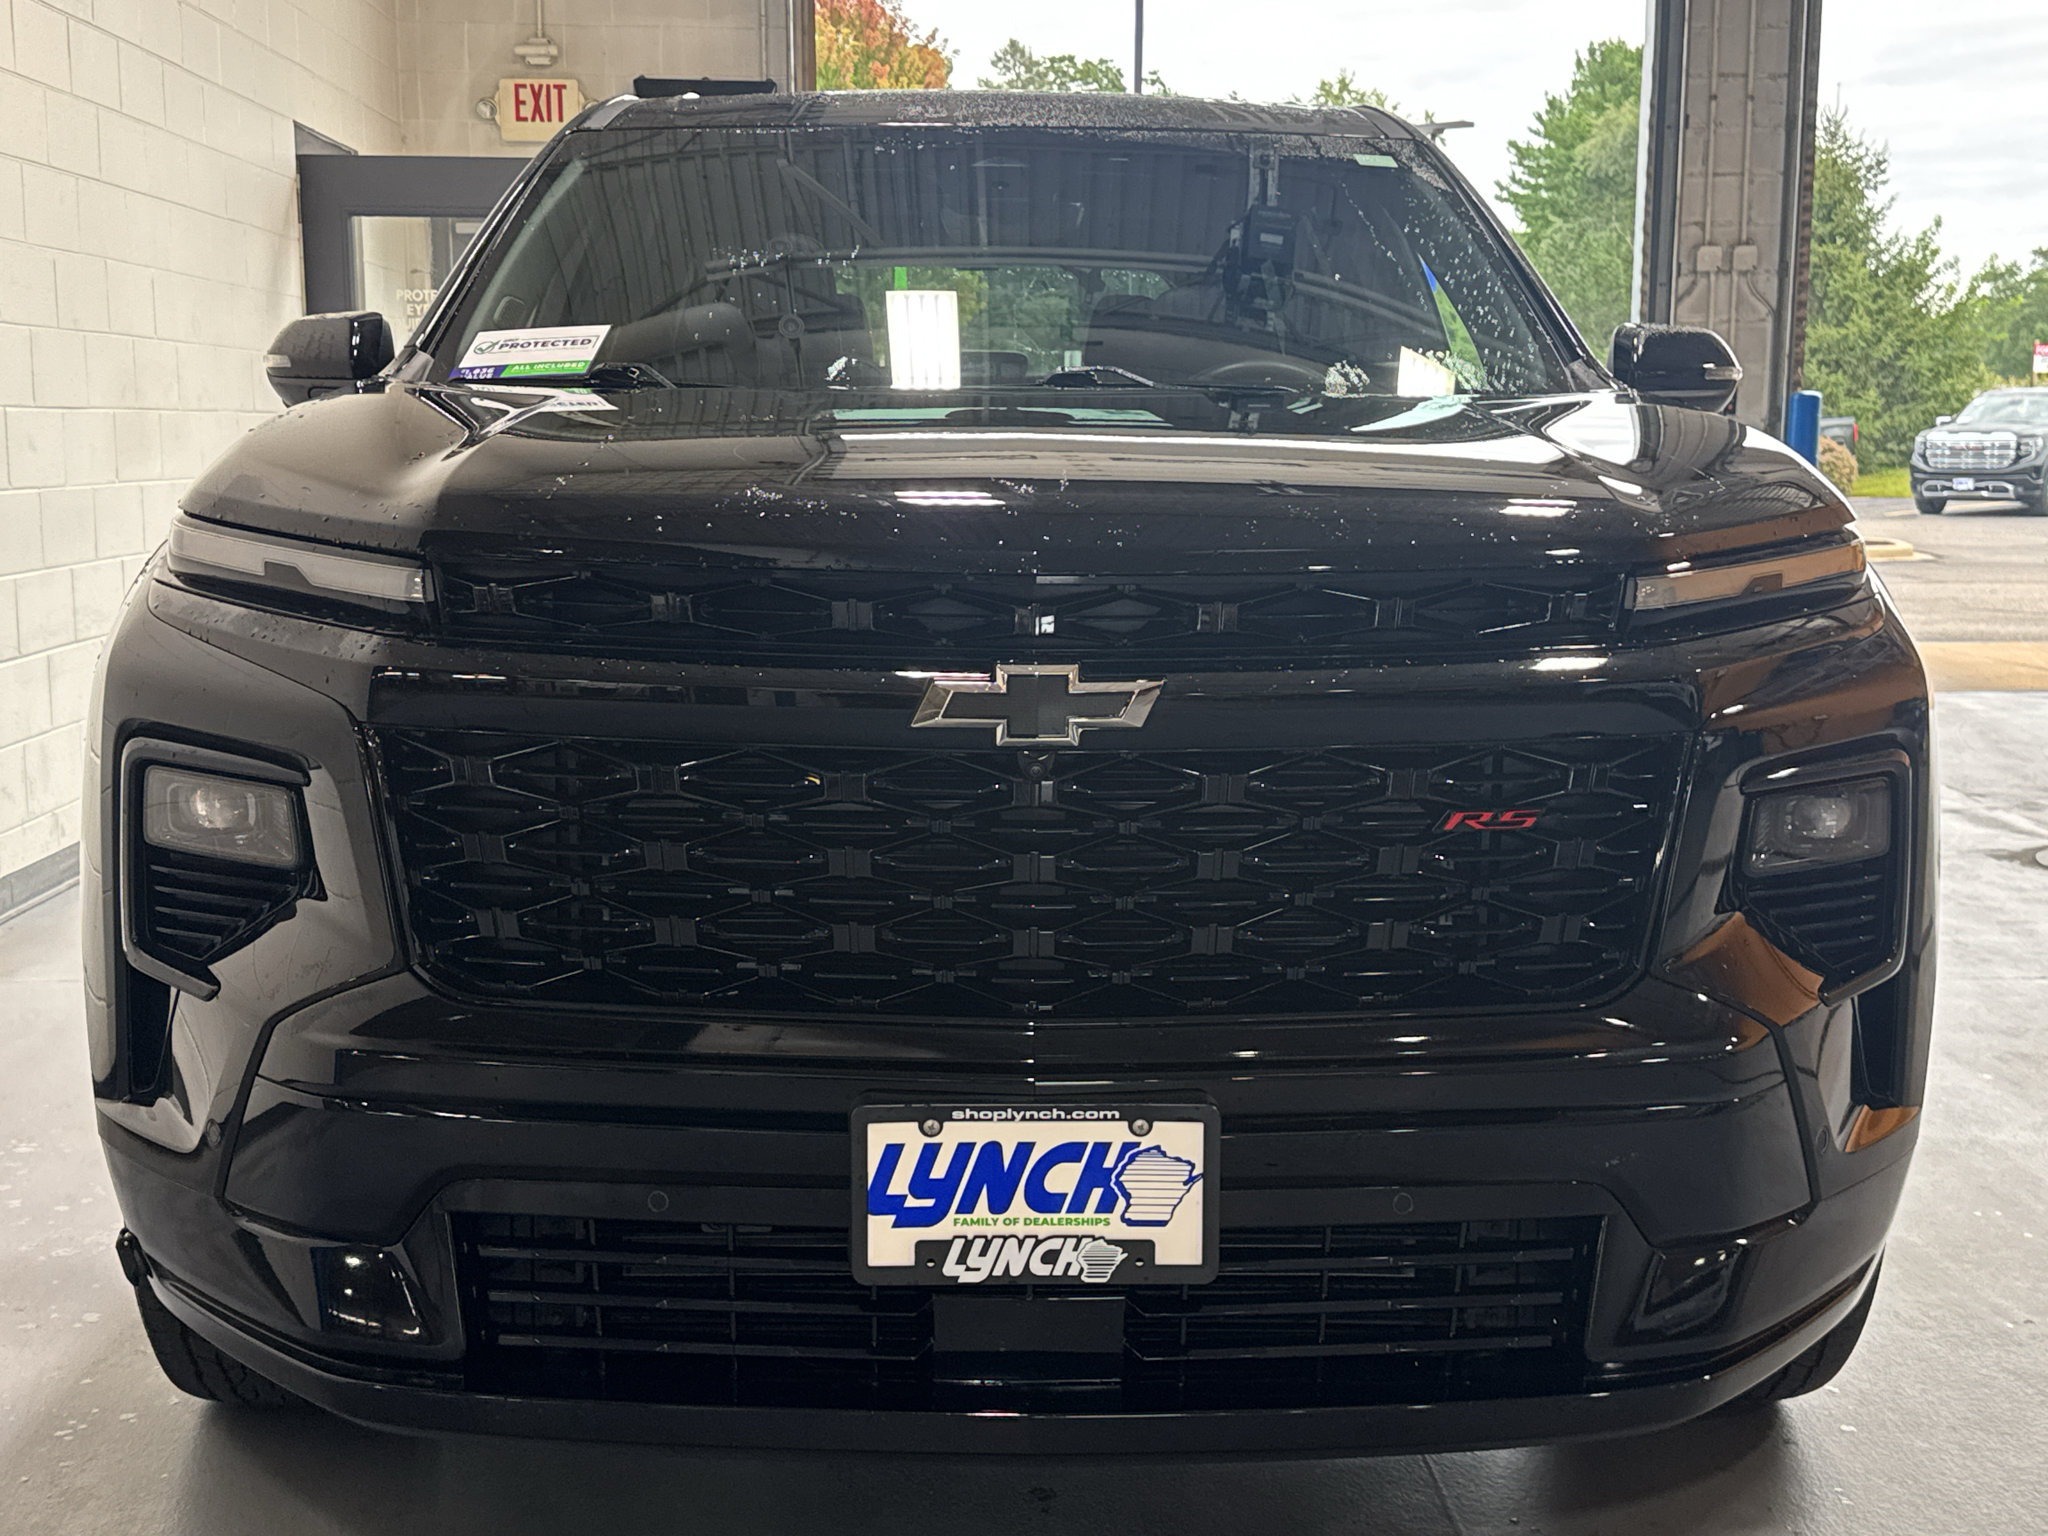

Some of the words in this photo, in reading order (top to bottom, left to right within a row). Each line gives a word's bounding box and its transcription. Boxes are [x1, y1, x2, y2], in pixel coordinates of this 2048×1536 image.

[514, 83, 567, 122] EXIT
[498, 338, 593, 350] PROTECTED
[512, 363, 531, 371] ALL
[534, 361, 586, 370] INCLUDED
[1443, 809, 1541, 831] RS
[951, 1108, 1120, 1122] shoplynch.com
[868, 1140, 1142, 1229] LYNCH
[953, 1218, 999, 1226] FAMILY
[1003, 1218, 1021, 1226] OF
[1023, 1218, 1111, 1226] DEALERSHIPS
[942, 1236, 1091, 1284] LYNCH
